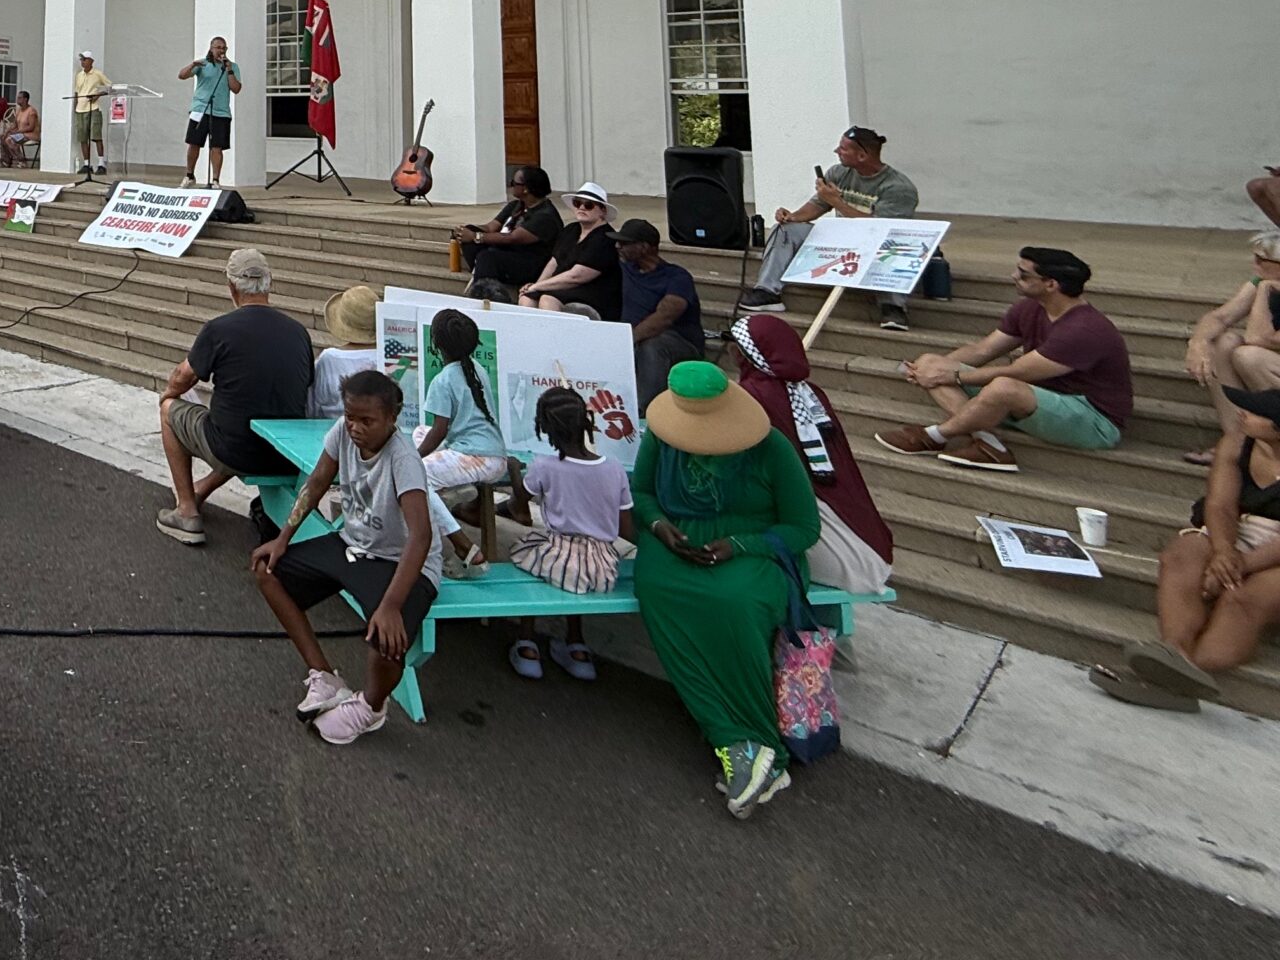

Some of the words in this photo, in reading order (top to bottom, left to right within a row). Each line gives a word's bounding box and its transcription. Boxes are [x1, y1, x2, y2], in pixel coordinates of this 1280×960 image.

[138, 191, 189, 207] SOLIDARITY
[112, 202, 146, 216] KNOWS
[145, 207, 160, 218] NO
[159, 209, 202, 221] BORDERS
[100, 216, 159, 233] CEASEFIRE
[156, 222, 192, 238] NOW
[484, 352, 494, 360] IS
[575, 381, 598, 390] OFF
